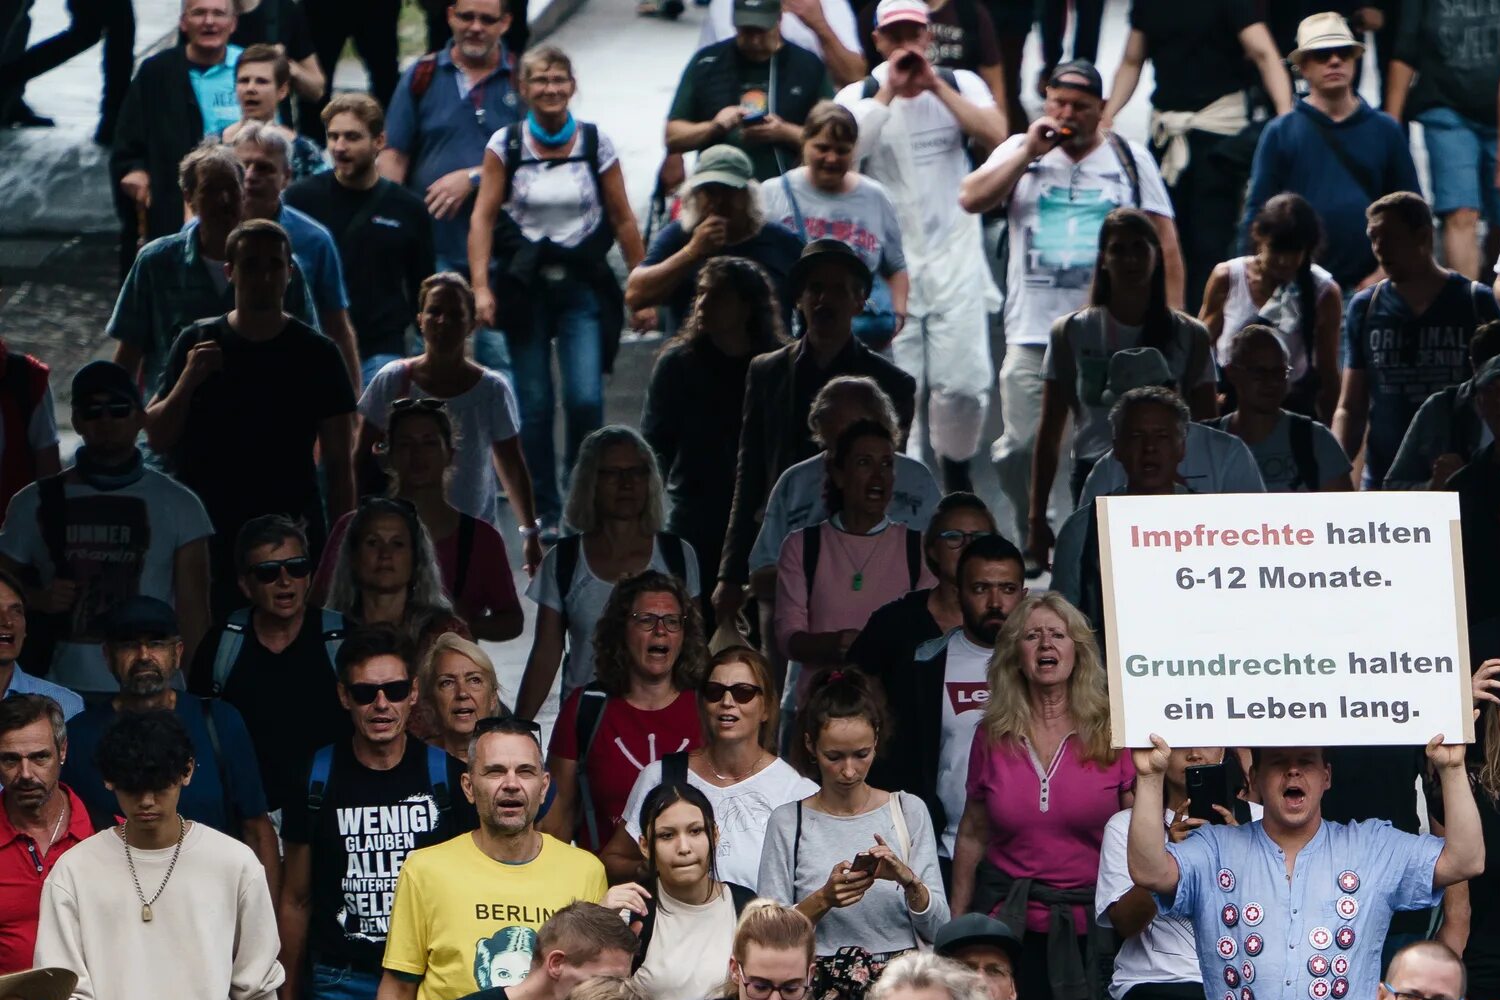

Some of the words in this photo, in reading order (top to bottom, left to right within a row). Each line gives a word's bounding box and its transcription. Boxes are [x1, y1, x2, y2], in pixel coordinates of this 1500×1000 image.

[1131, 523, 1314, 552] Impfrechte
[1326, 521, 1431, 545] halten
[1176, 566, 1247, 590] 6-12
[1259, 565, 1393, 589] Monate.
[1125, 653, 1337, 678] Grundrechte
[1348, 651, 1453, 674] halten
[958, 690, 990, 703] Le
[1164, 698, 1215, 720] ein
[1226, 697, 1328, 719] Leben
[1339, 695, 1421, 724] lang.
[336, 804, 429, 836] WENIG
[345, 832, 416, 853] GLAUBEN
[346, 850, 417, 879] ALLE
[344, 892, 395, 917] SELB
[475, 903, 556, 924] BERLIN
